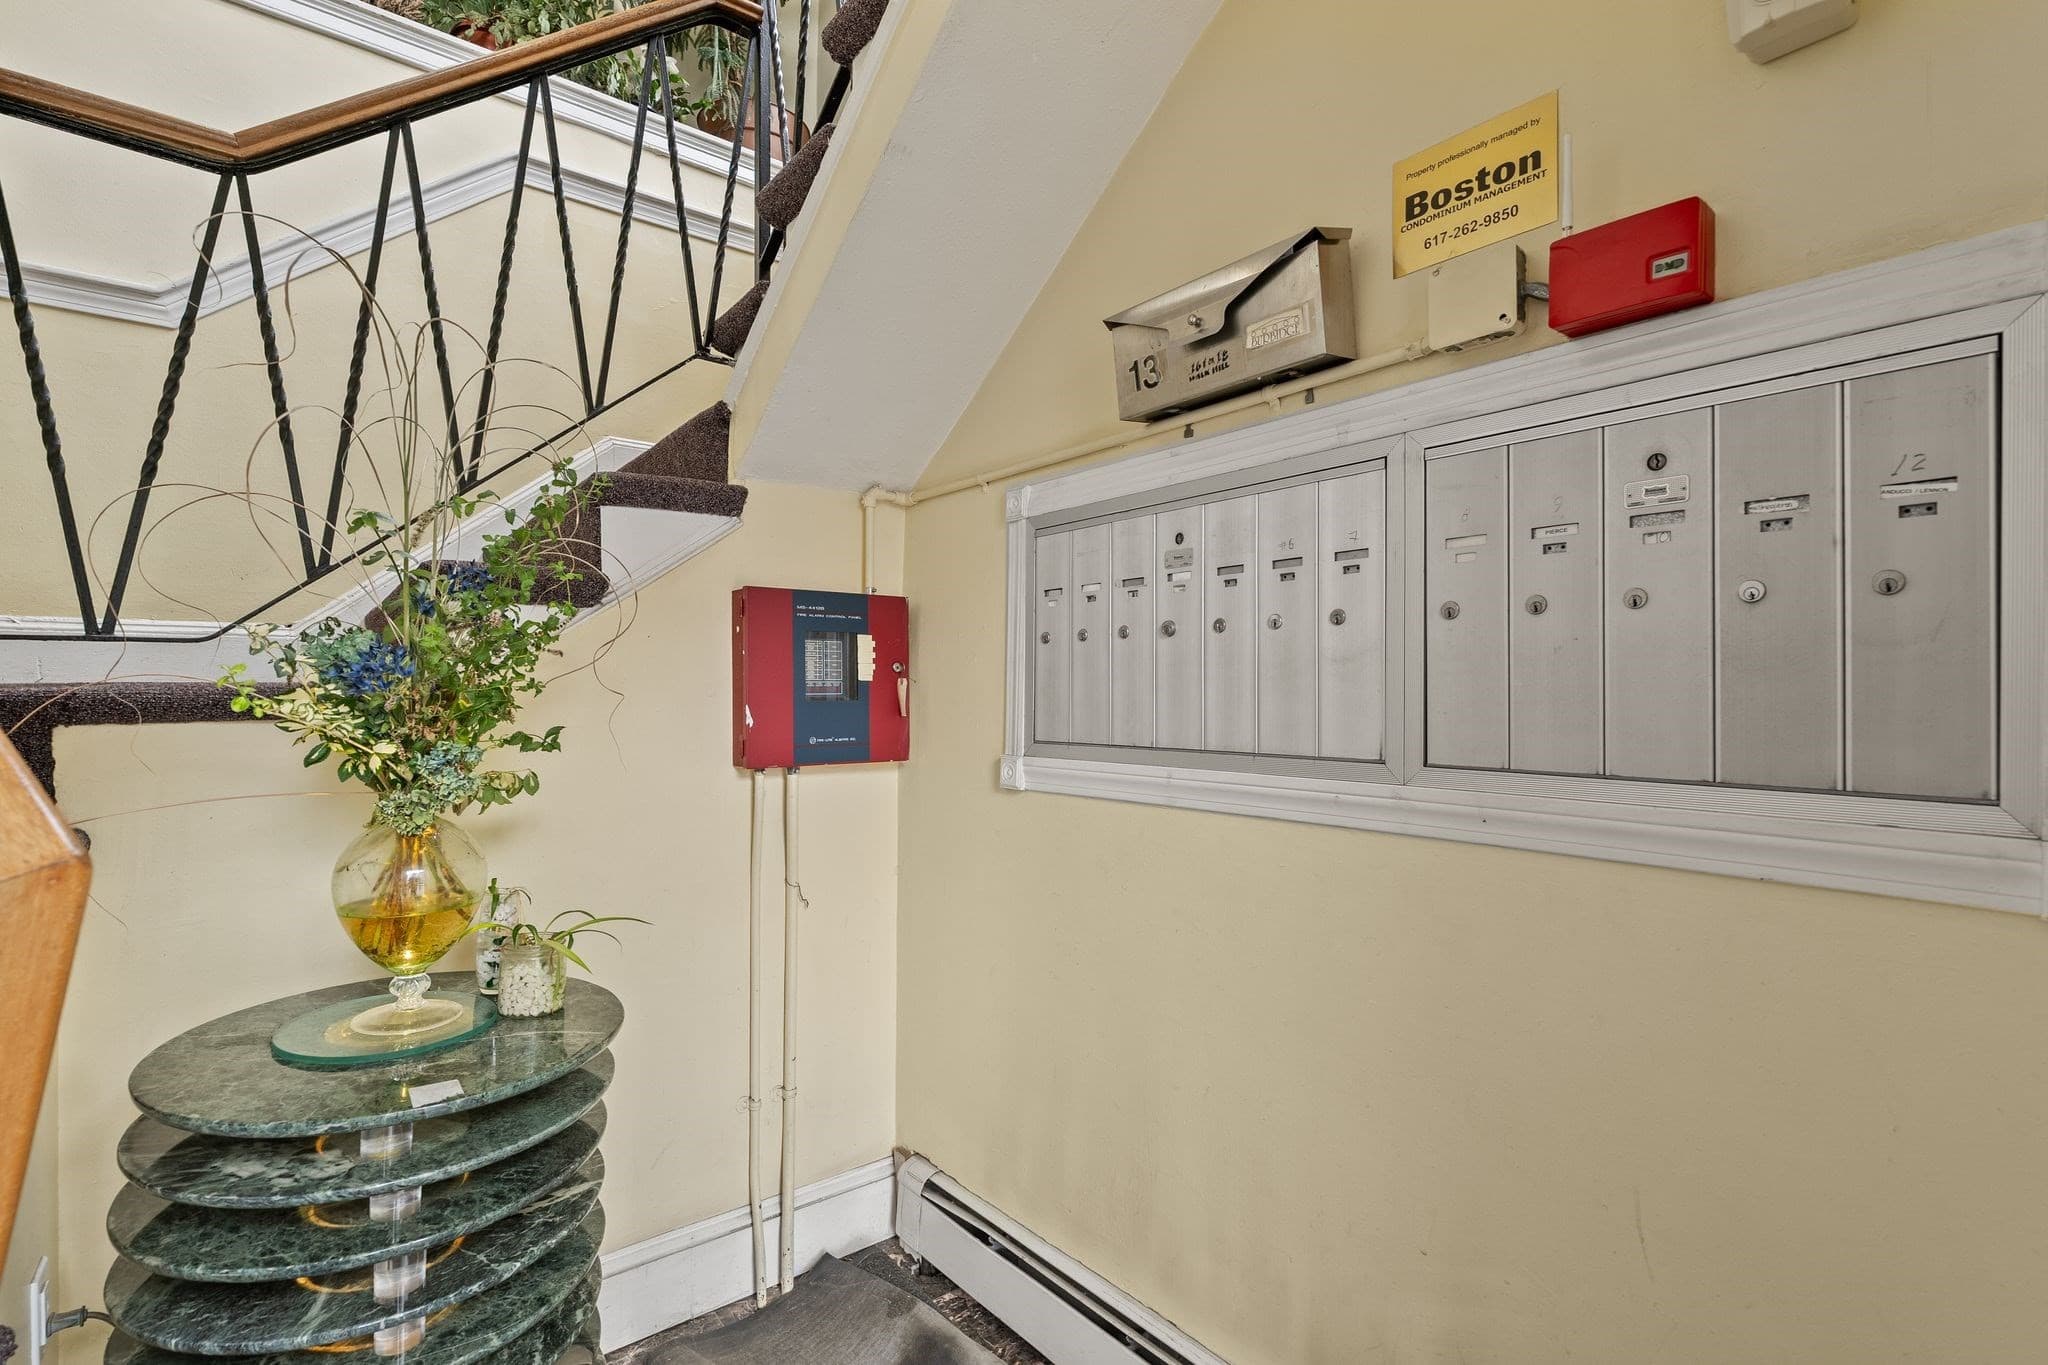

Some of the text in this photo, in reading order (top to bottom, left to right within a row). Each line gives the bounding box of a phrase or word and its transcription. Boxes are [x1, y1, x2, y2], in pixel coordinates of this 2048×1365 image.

[1405, 117, 1541, 181] Property professionally managed by
[1400, 168, 1548, 233] CONDOMINIUM MANAGEMENT
[1405, 150, 1542, 222] Boston
[1424, 204, 1519, 249] 617-262-9850
[1128, 354, 1161, 391] 13
[1891, 454, 1926, 476] 12
[1545, 527, 1568, 535] PIERCE
